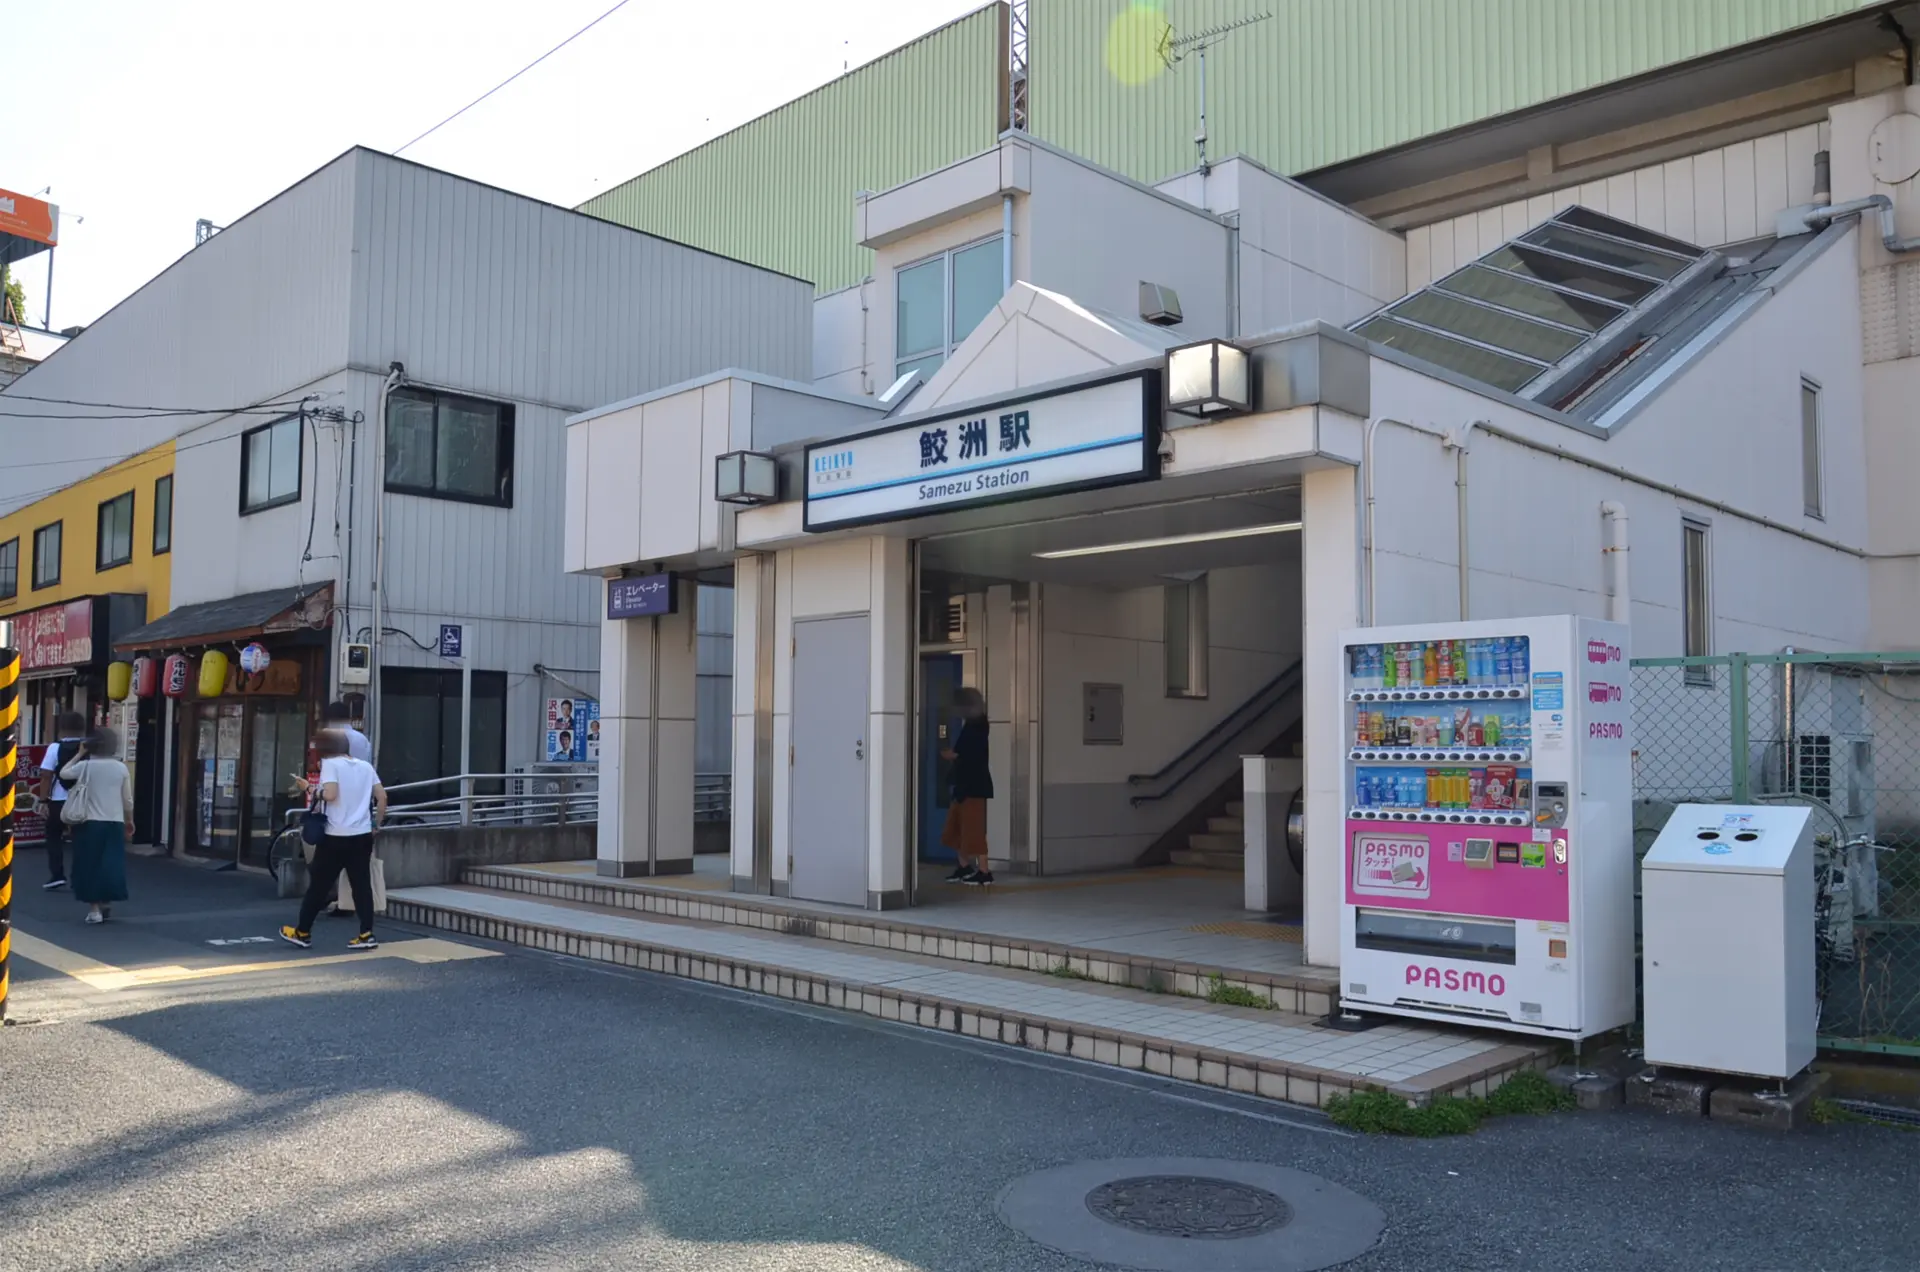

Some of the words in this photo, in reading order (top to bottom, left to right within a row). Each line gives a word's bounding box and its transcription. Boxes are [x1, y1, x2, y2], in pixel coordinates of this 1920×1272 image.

[918, 410, 1031, 468] 鮫洲駅
[814, 451, 853, 473] KEIKYU
[918, 480, 973, 500] Samezu
[976, 469, 1029, 491] Station
[626, 582, 666, 596] エレベーター
[171, 660, 188, 692] ホルモン
[1589, 722, 1623, 738] PASMO
[1365, 843, 1425, 858] PASMO
[1406, 965, 1506, 996] PASMO
